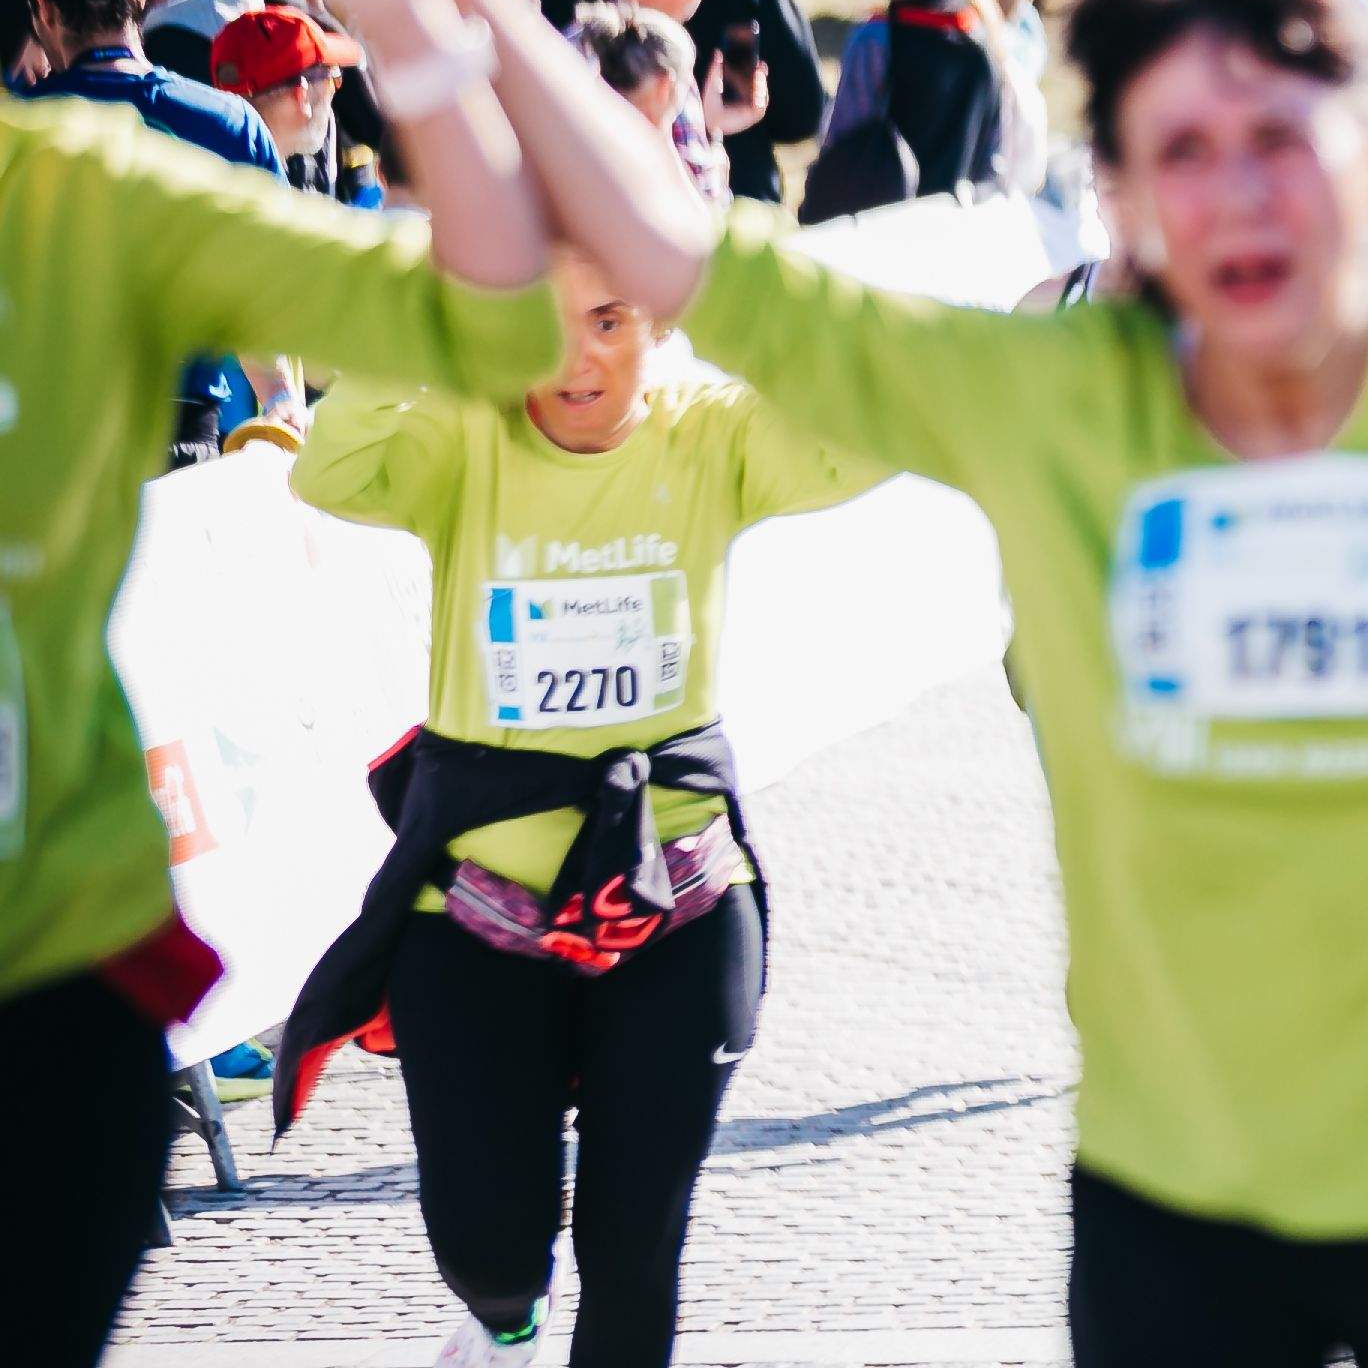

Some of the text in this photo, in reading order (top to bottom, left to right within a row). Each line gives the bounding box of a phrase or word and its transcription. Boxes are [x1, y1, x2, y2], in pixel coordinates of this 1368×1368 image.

[548, 533, 678, 572] MetLife
[562, 595, 643, 617] MetLife
[536, 665, 640, 713] 2270
